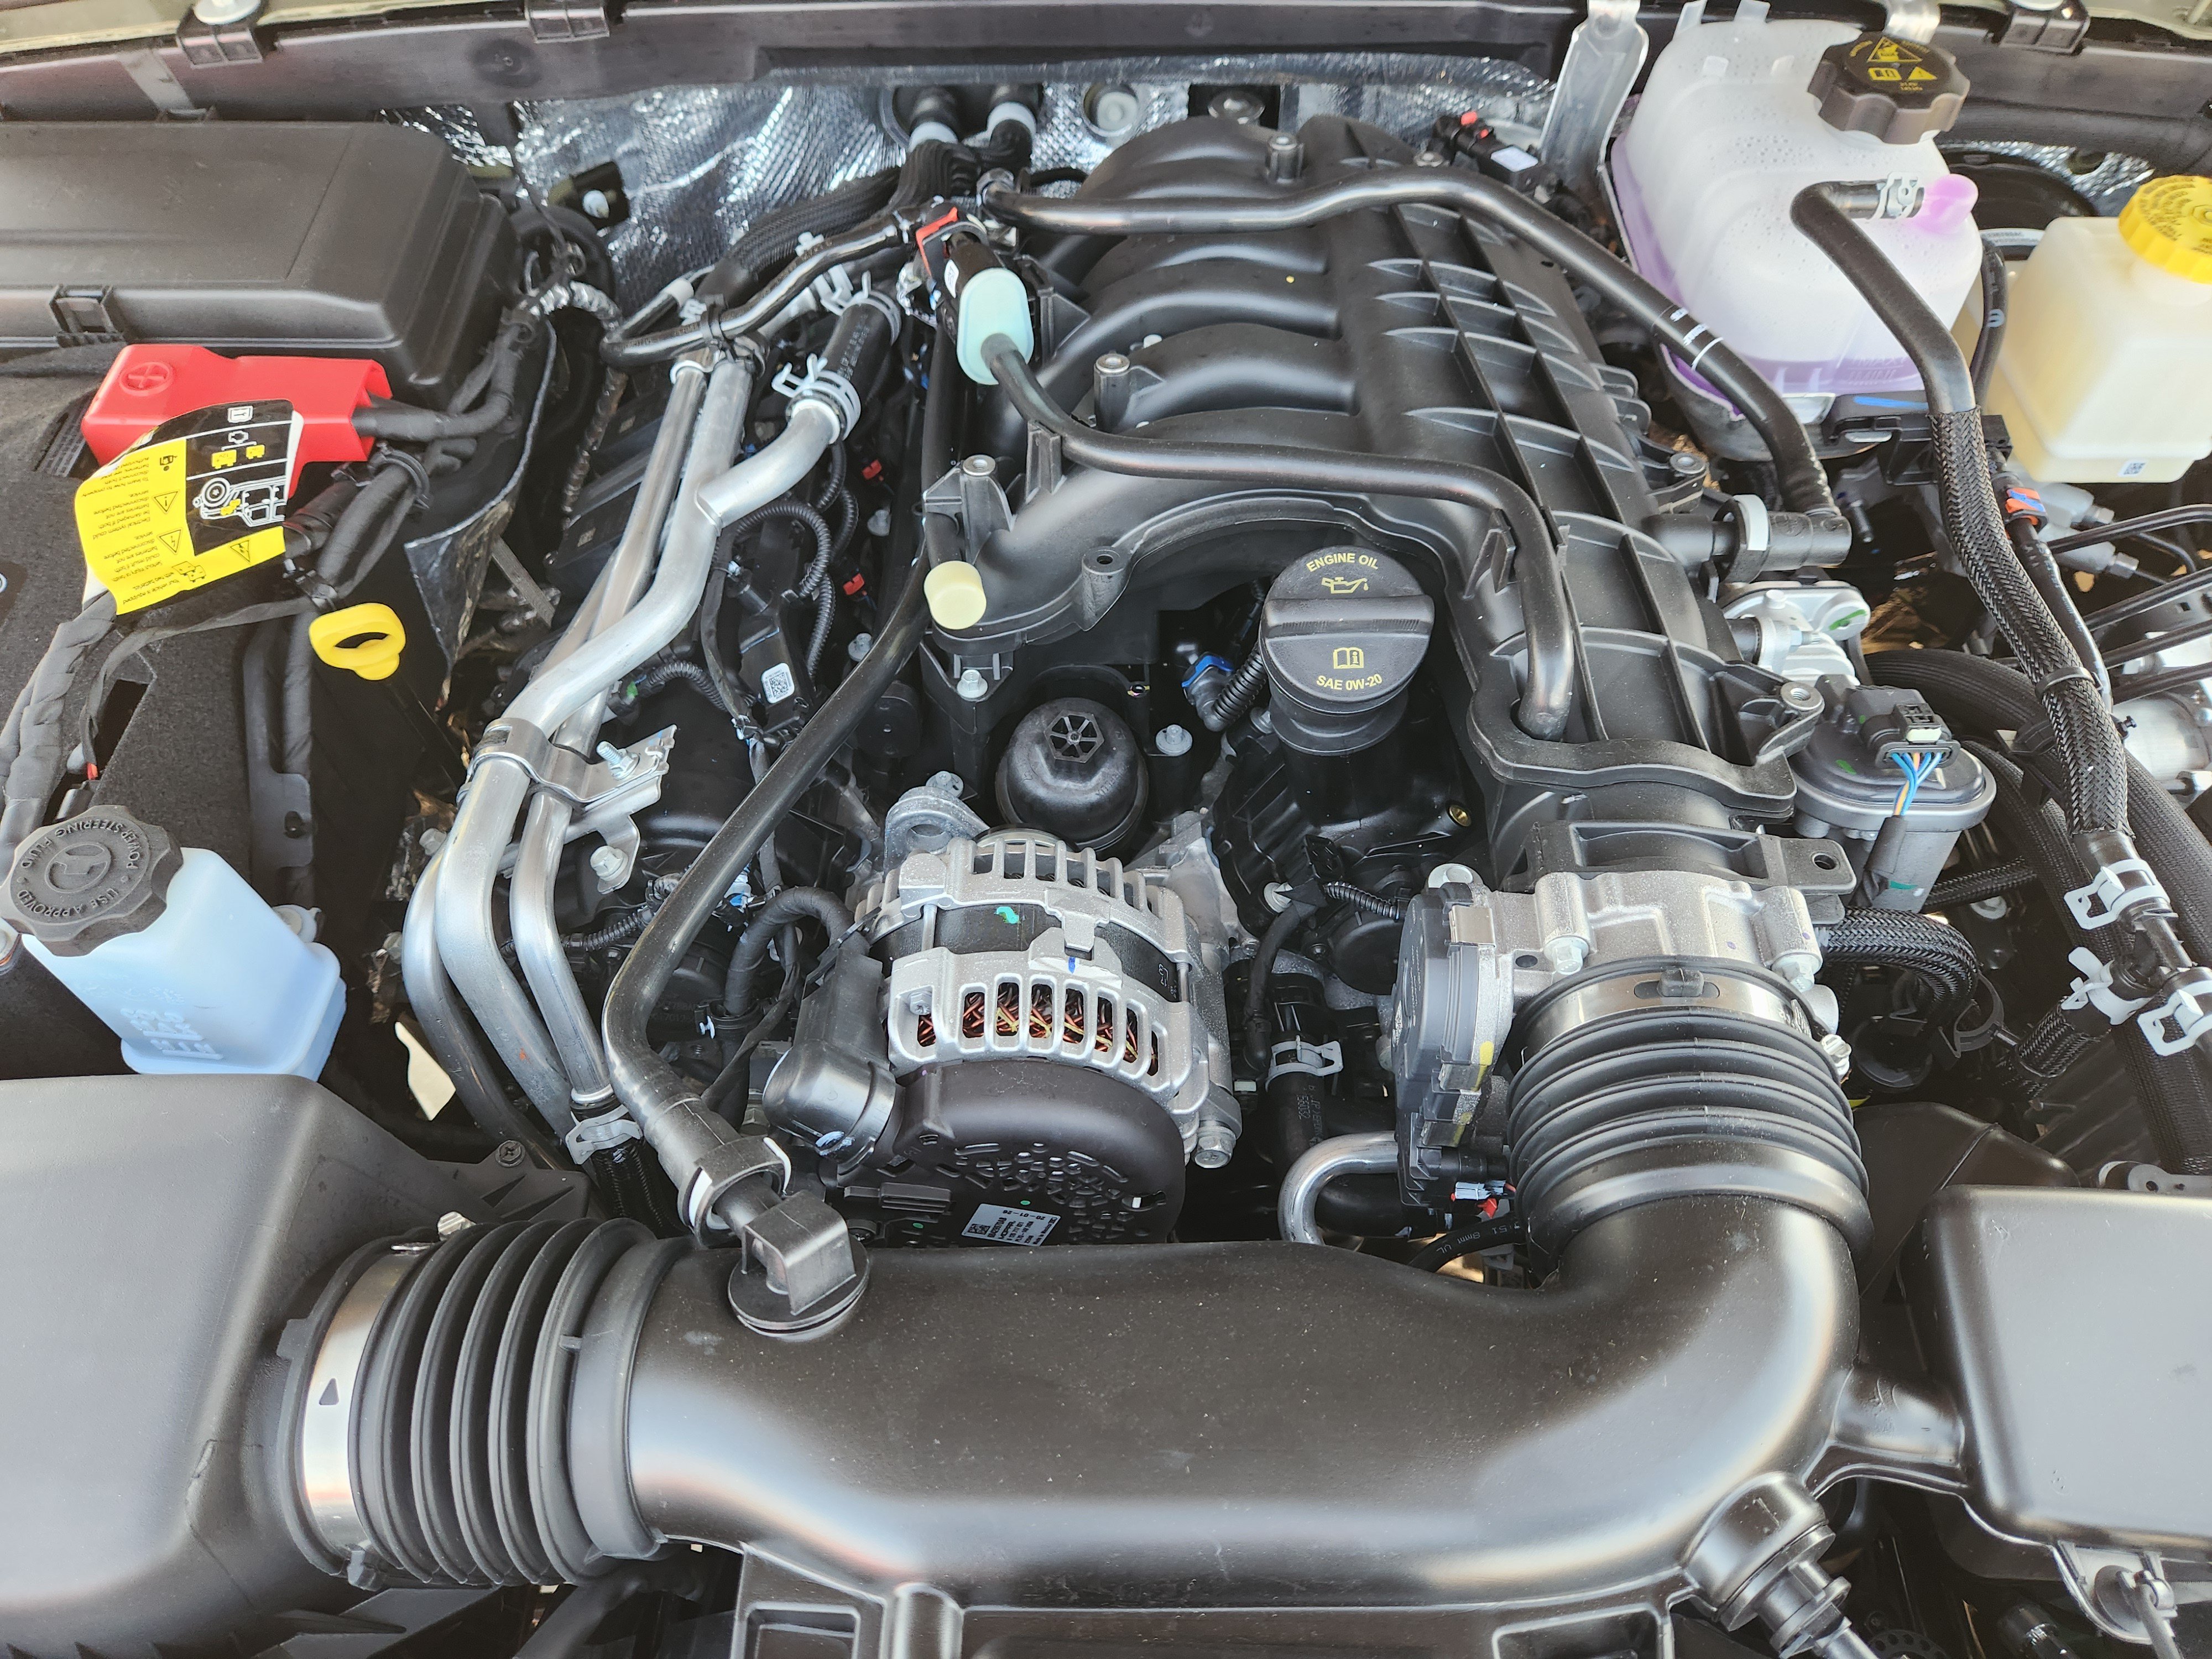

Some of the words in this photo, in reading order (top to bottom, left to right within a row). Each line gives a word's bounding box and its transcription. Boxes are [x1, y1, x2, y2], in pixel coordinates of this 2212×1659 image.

[121, 457, 149, 468] authorized
[119, 471, 148, 481] disconnect
[81, 487, 105, 497] properly
[112, 497, 149, 510] disconnected
[126, 504, 149, 513] batteries
[93, 507, 111, 515] before
[117, 513, 142, 524] damaged
[127, 517, 150, 528] Electrical
[108, 524, 126, 533] system
[92, 531, 107, 540] could
[121, 539, 154, 554] disconnected
[135, 546, 158, 556] batteries
[103, 551, 121, 560] before
[131, 559, 144, 567] result
[1306, 552, 1356, 572] ENGINE
[1358, 555, 1379, 570] OIL
[152, 583, 167, 592] vehicle
[123, 593, 145, 604] equipped
[1316, 675, 1343, 691] SAE
[1345, 674, 1383, 691] 0W-20
[55, 818, 125, 837] STEERING
[20, 837, 53, 869] FLUID
[120, 830, 142, 869] POWER
[17, 889, 84, 917] APPROVED
[90, 888, 119, 908] USE
[1457, 1232, 1481, 1244] 8mm
